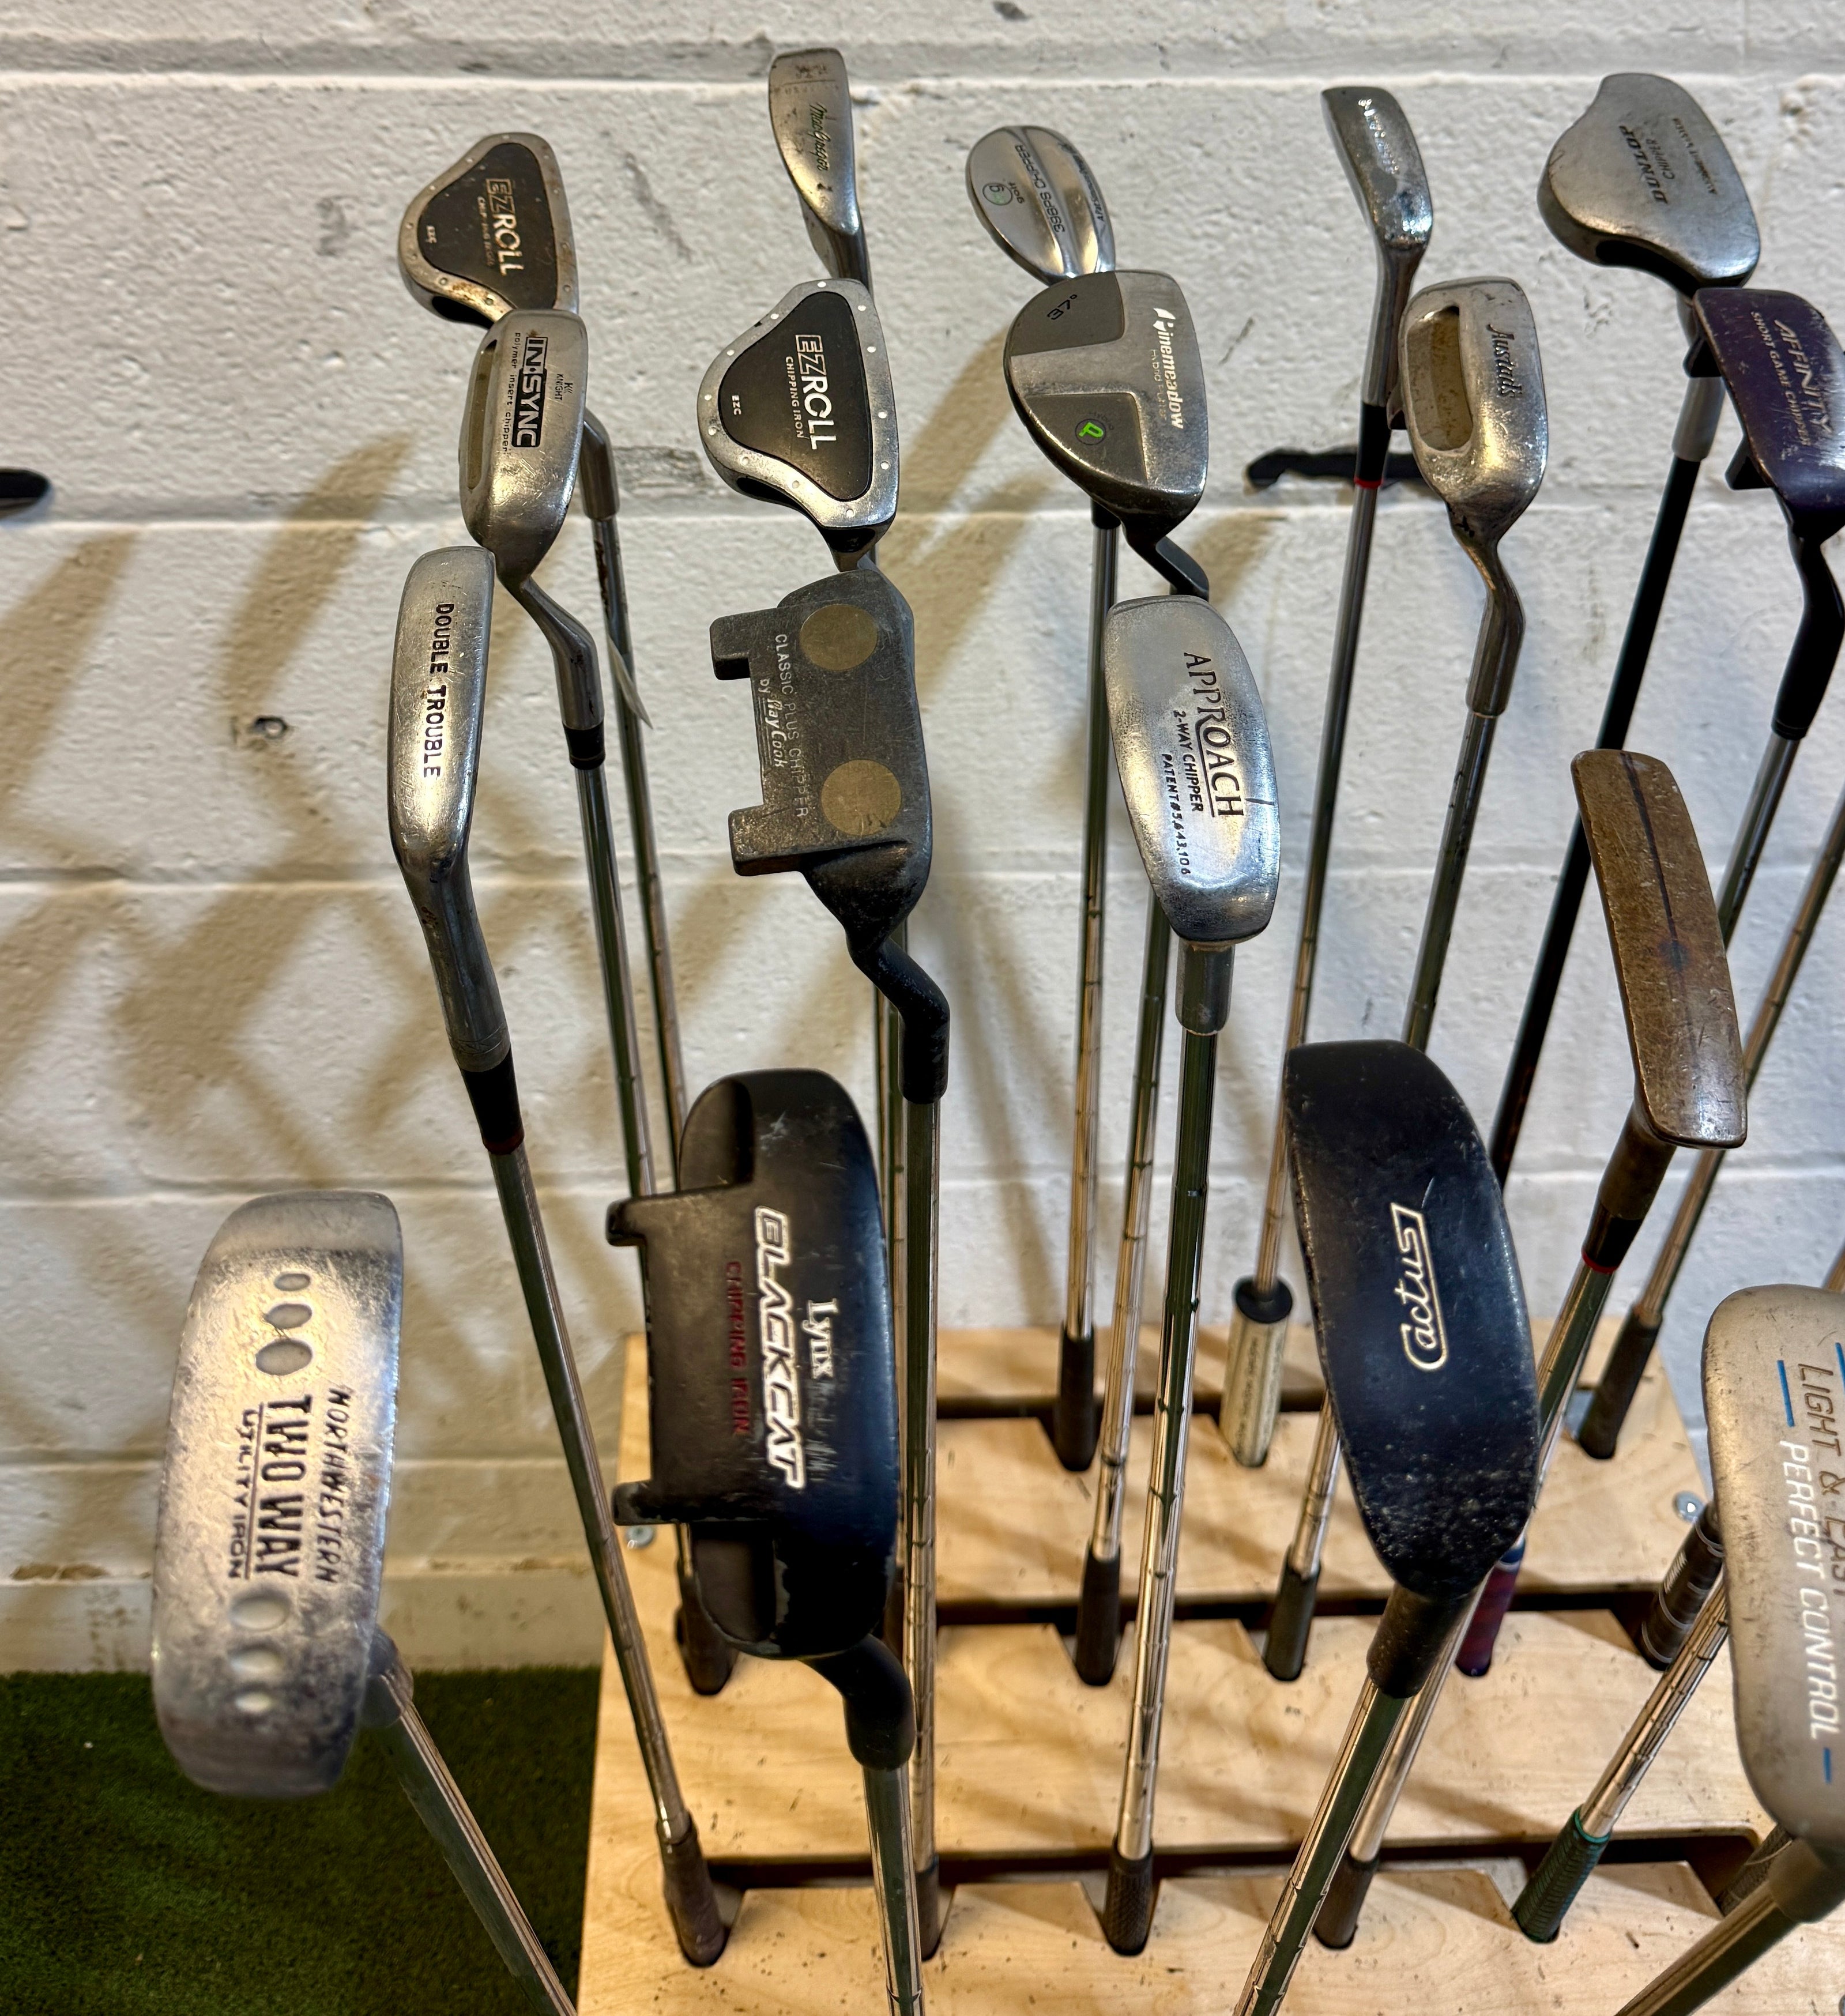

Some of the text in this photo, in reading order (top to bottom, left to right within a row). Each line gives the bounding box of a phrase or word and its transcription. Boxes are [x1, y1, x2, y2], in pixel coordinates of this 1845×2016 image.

[1008, 182, 1025, 204] golf
[1015, 145, 1065, 233] 396PS CHIPPER
[1619, 125, 1669, 205] DUNLOP
[1646, 138, 1675, 180] CHIPPER
[485, 178, 524, 276] EZROLL
[507, 375, 516, 406] insert
[511, 332, 521, 369] polymer
[554, 374, 564, 401] KNIGHT
[785, 356, 805, 438] CHIPPING IRON
[795, 334, 837, 450] EZROLL
[1751, 311, 1812, 446] SHORT GAME CHIPPER
[1774, 319, 1832, 432] AFFINITY
[732, 395, 742, 415] EZC
[423, 603, 455, 778] DOUBLE TROUBLE
[758, 679, 771, 694] by
[775, 634, 793, 695] CLASSIC
[784, 702, 799, 741] PLUS
[1184, 651, 1245, 817] APPROACH
[1173, 710, 1203, 812] 2-WAY CHIPPER
[727, 1261, 747, 1369] CHIPPING
[1390, 1203, 1448, 1371] Cactus
[755, 1205, 805, 1489] BLACKCAT
[801, 1298, 838, 1380] Lynx
[1798, 1363, 1841, 1456] LIGHT
[228, 1409, 257, 1578] UTILITY IRON
[255, 1394, 312, 1577] TWO WAY
[315, 1388, 351, 1583] NORTHWESTERN
[1780, 1441, 1840, 1740] PERFECT CONTROL
